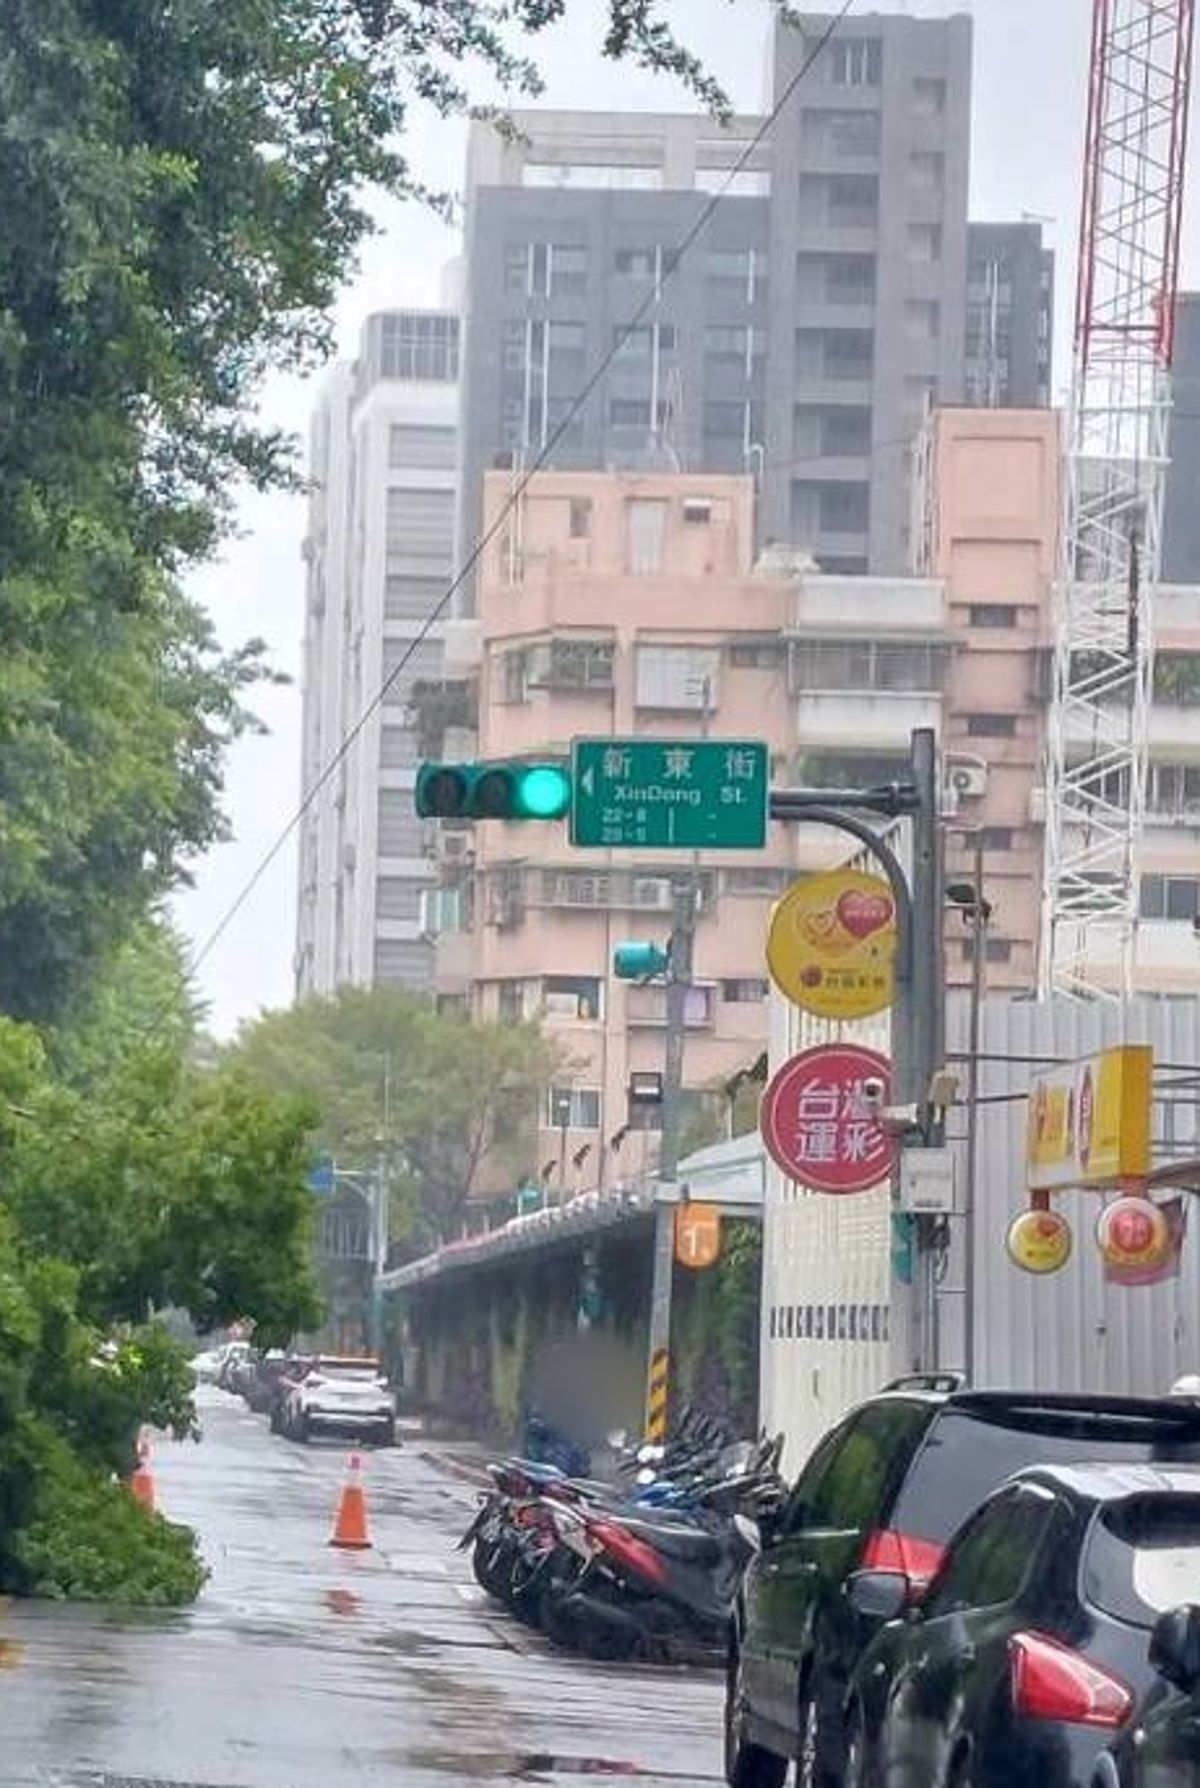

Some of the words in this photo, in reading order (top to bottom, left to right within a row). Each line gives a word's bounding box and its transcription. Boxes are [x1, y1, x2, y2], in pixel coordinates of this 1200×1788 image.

[603, 746, 756, 781] 新東街
[614, 785, 700, 805] XinDong
[720, 787, 747, 804] St.
[795, 1121, 885, 1162] 運彩
